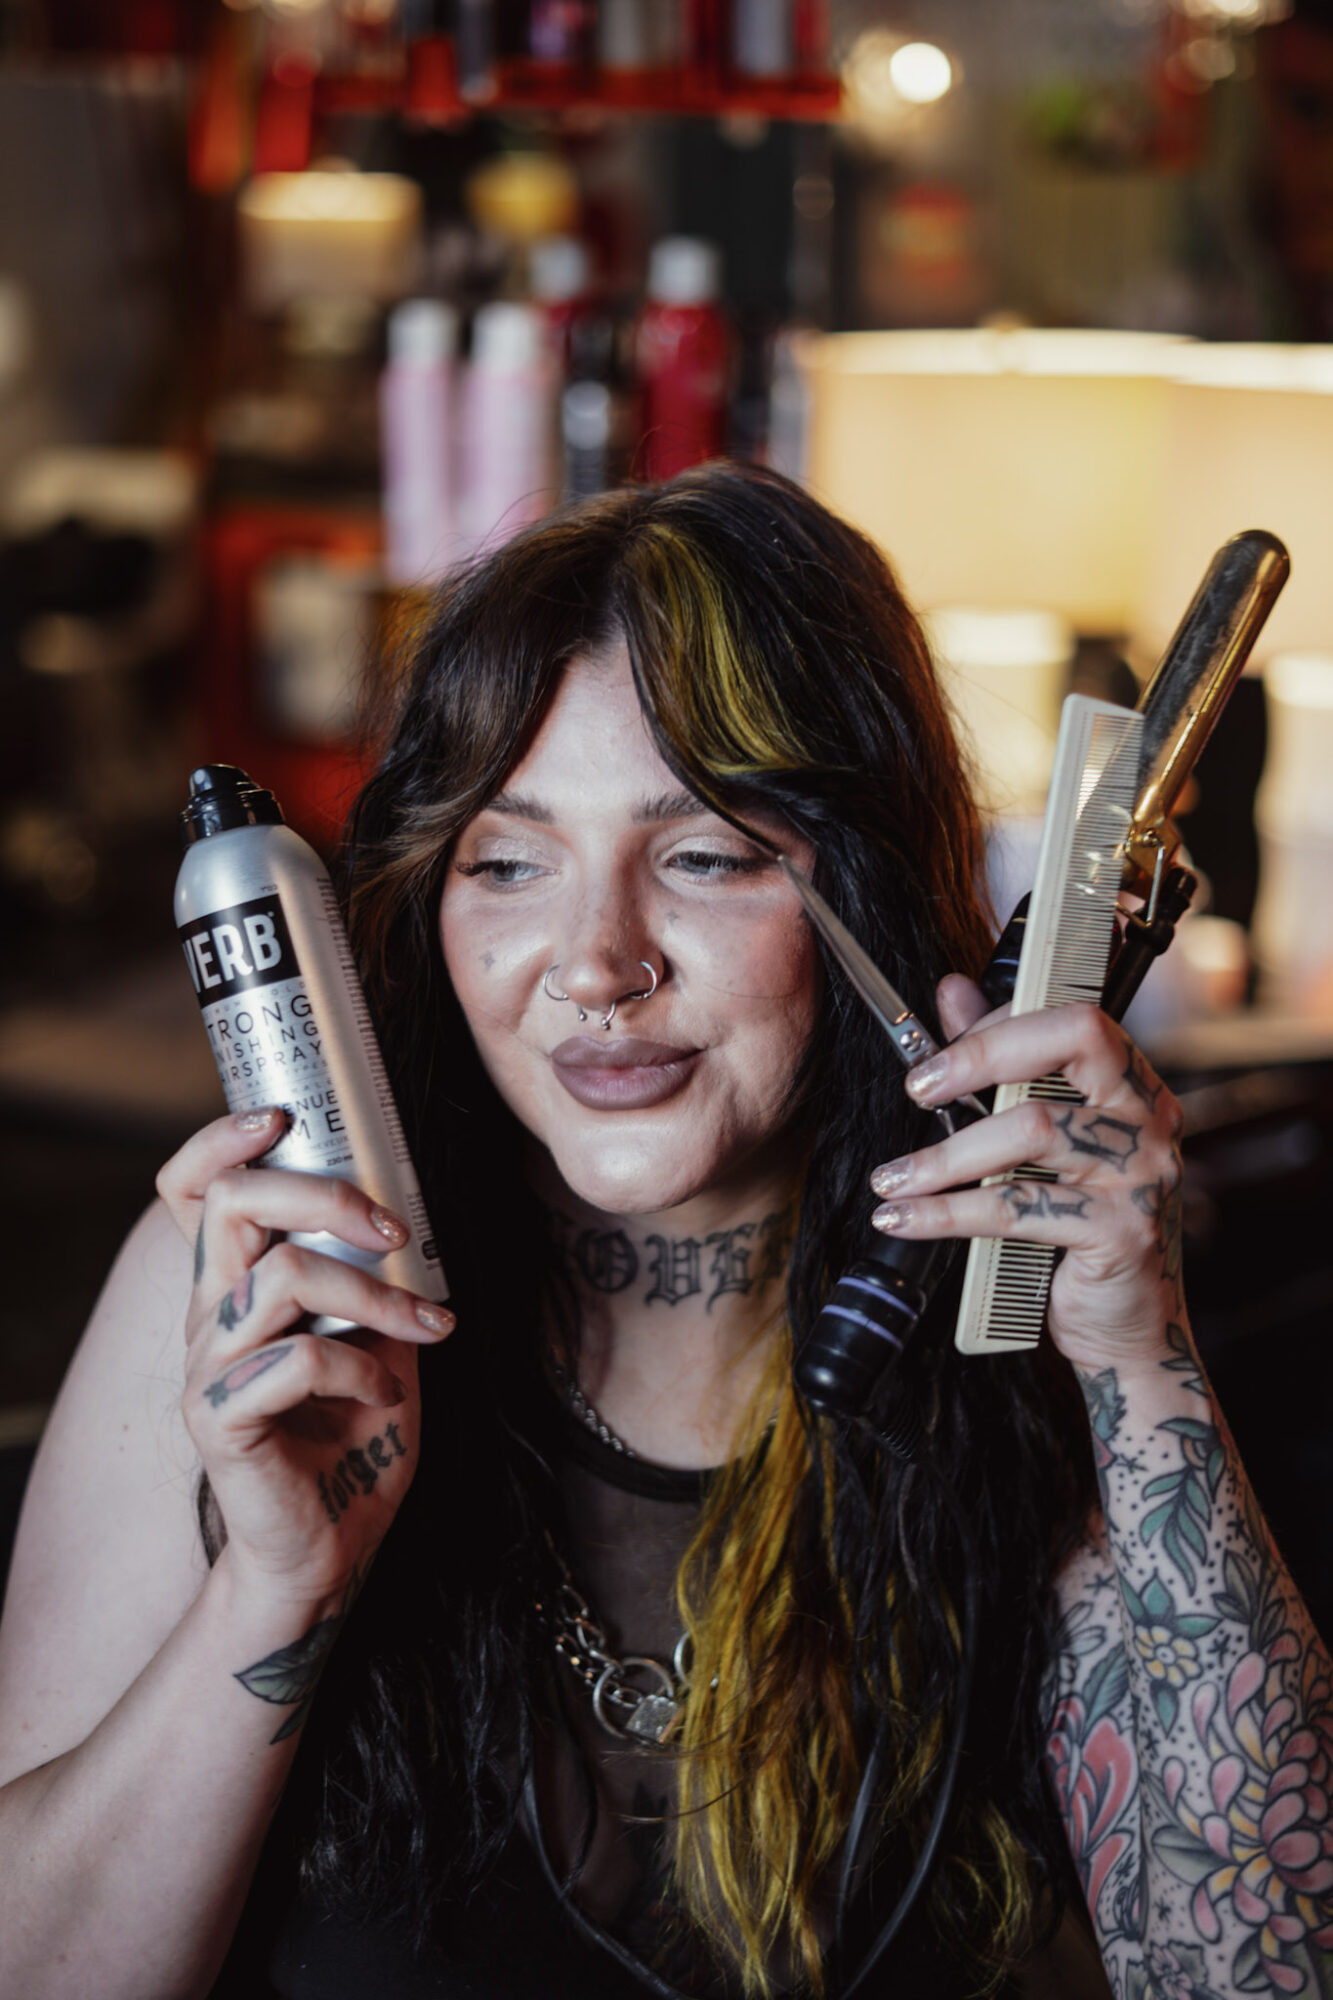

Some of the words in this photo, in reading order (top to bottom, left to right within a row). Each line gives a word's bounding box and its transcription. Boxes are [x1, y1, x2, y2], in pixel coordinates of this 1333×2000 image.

[207, 995, 312, 1043] TRONG
[216, 1020, 318, 1064] NISHING
[221, 1040, 322, 1084] IRSPRAY
[282, 1089, 338, 1117] ENUE
[287, 1108, 345, 1143] ME
[317, 1421, 408, 1525] forget
